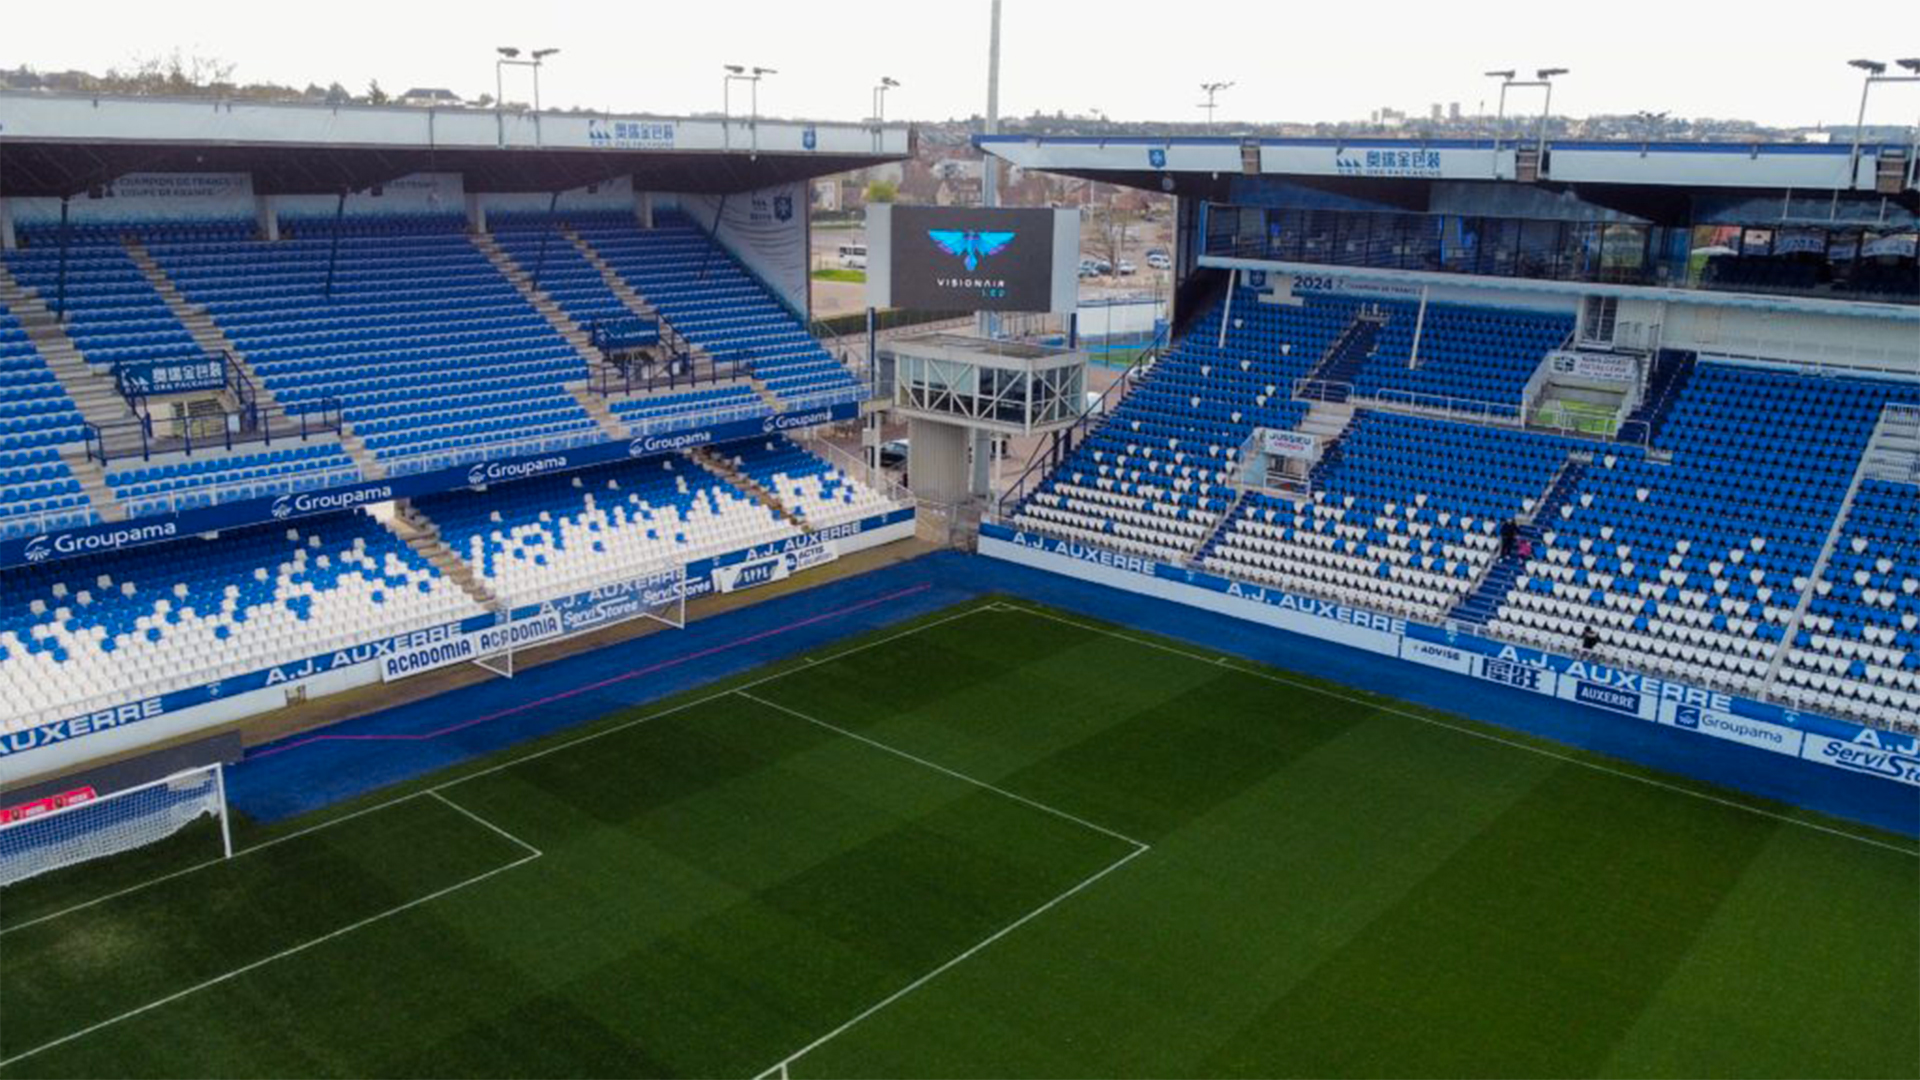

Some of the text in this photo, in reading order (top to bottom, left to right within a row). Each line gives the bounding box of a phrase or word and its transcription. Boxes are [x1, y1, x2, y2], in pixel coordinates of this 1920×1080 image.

[1293, 275, 1332, 290] 2024
[775, 411, 833, 430] Groupama
[644, 430, 711, 452] Groupama
[487, 456, 566, 479] Groupama
[295, 485, 392, 513] Groupama
[54, 520, 176, 553] Groupama
[746, 543, 779, 561] A.J.
[784, 521, 861, 552] AUXERRE
[1013, 532, 1156, 575] A.J. AUXERRE
[589, 568, 686, 601] AUXERRE
[644, 579, 711, 604] ServiStores
[564, 598, 639, 626] ServiStores
[1227, 582, 1407, 634] A.J. AUXERRE
[480, 616, 558, 650] ACADOMIA
[265, 622, 462, 686] A.J. AUXERRE
[387, 639, 472, 676] ACADOMIA
[1498, 645, 1556, 669] A.J.
[1565, 661, 1733, 713] AUXERRE
[1581, 686, 1636, 710] AUXERRE
[0, 698, 163, 755] UXERRE
[1702, 713, 1783, 744] Groupama
